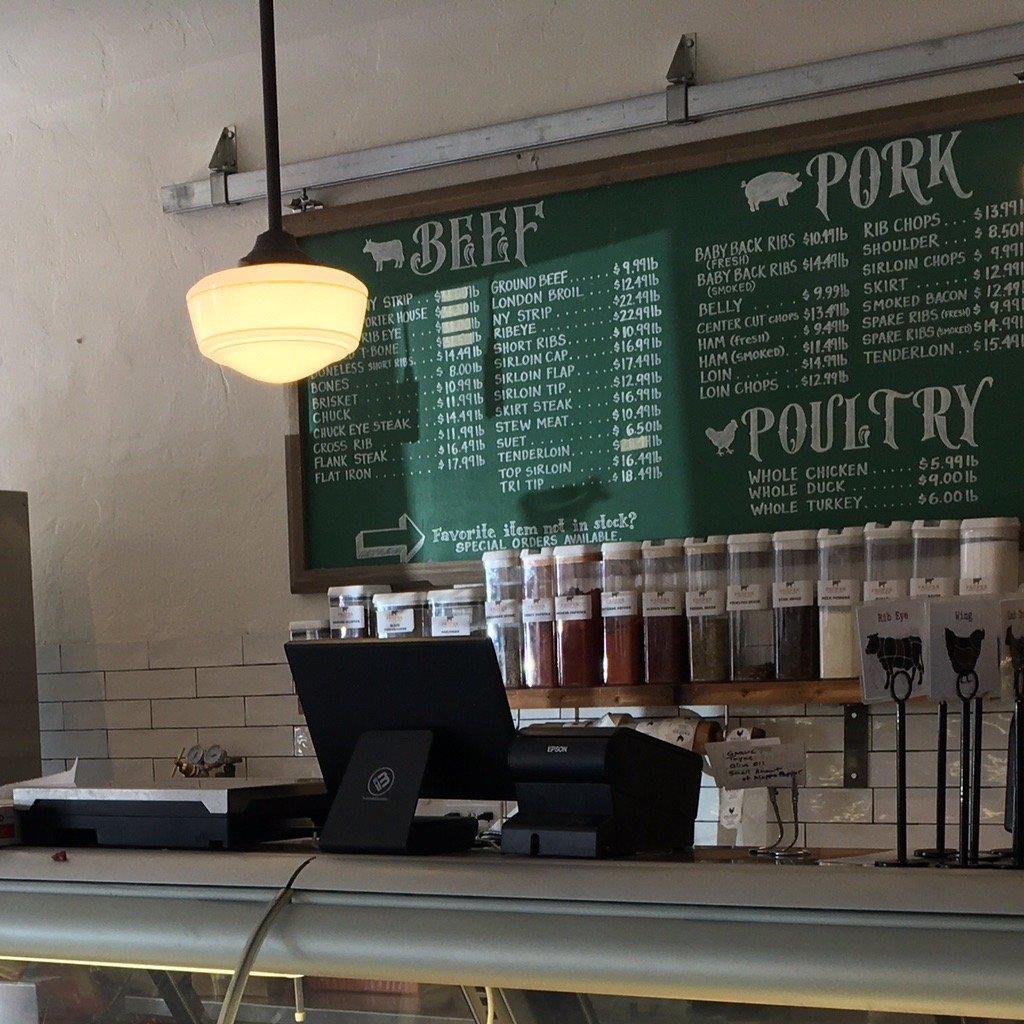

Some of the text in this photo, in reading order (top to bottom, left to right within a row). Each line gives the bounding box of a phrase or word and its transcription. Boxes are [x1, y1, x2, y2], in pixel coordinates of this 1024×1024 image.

[806, 130, 973, 222] PORK
[864, 213, 941, 238] RIB CHOPS
[410, 200, 545, 276] BEEF
[695, 233, 796, 262] BABY BACK RIBS
[862, 233, 940, 256] SHOULDER
[706, 254, 750, 270] (FRESH)
[862, 251, 966, 276] SIRLOIN CHOPS
[491, 270, 569, 295] GROUND BEEF
[697, 259, 798, 287] BABY BACK RIBS
[707, 280, 756, 298] (SMOKED)
[863, 277, 908, 295] SKIRT
[383, 293, 413, 308] STRIP
[492, 290, 542, 310] LONDON
[548, 286, 584, 302] BROIL
[698, 298, 742, 317] BELLY
[862, 289, 967, 313] SMOKED BACON
[397, 307, 427, 323] HOUSE
[492, 311, 510, 326] NY
[517, 306, 553, 322] STRIP
[697, 314, 767, 334] CENTER CUT
[862, 309, 939, 329] SPARE RIBS
[382, 328, 401, 340] EYE
[494, 322, 537, 340] RIBEYE
[862, 326, 935, 346] SPARE RIBS
[493, 340, 533, 354] SHORT
[536, 334, 567, 350] RIBS
[698, 335, 726, 351] HAM
[494, 353, 542, 369] SIRLOIN
[545, 349, 568, 363] CAP
[699, 352, 728, 368] HAM
[863, 342, 955, 365] TENDERLOIN
[495, 368, 541, 385] SIRLOIN
[547, 365, 575, 380] FLAP
[700, 368, 732, 384] LOIN
[310, 378, 350, 394] BONES
[494, 385, 541, 401] SIRLOIN
[546, 382, 566, 396] TIP
[699, 378, 779, 400] LOIN CHOPS
[312, 394, 358, 410] BRISKET
[495, 403, 528, 418] SKIRT
[533, 399, 573, 413] STEAK
[312, 409, 351, 424] CHUCK
[495, 419, 531, 433] STEW
[536, 415, 569, 430] MEAT
[741, 376, 994, 463] POULTRY
[313, 425, 346, 440] CHUCK
[349, 422, 370, 436] EYE
[374, 418, 412, 431] STEAK
[313, 440, 348, 455] CROSS
[353, 438, 373, 451] RIB
[496, 435, 527, 449] SUET
[314, 454, 347, 469] FLANK
[354, 450, 388, 465] STEAK
[498, 445, 570, 463] TENDERLOIN
[315, 470, 341, 484] FLAT
[345, 468, 372, 481] IRON
[499, 467, 521, 480] TOP
[526, 461, 572, 477] SIRLOIN
[748, 461, 869, 485] WHOLE CHICKEN
[500, 479, 520, 493] TRI
[525, 477, 544, 491] TIP
[748, 480, 846, 500] WHOLE DUCK
[750, 496, 863, 516] WHOLE TURKEY
[431, 511, 637, 542] Favorite item not in stock?
[455, 536, 508, 553] SPECIAL
[512, 535, 558, 549] ORDERS
[877, 611, 909, 623] Rib Eye
[954, 611, 973, 623] Wing
[547, 745, 568, 753] EPSON
